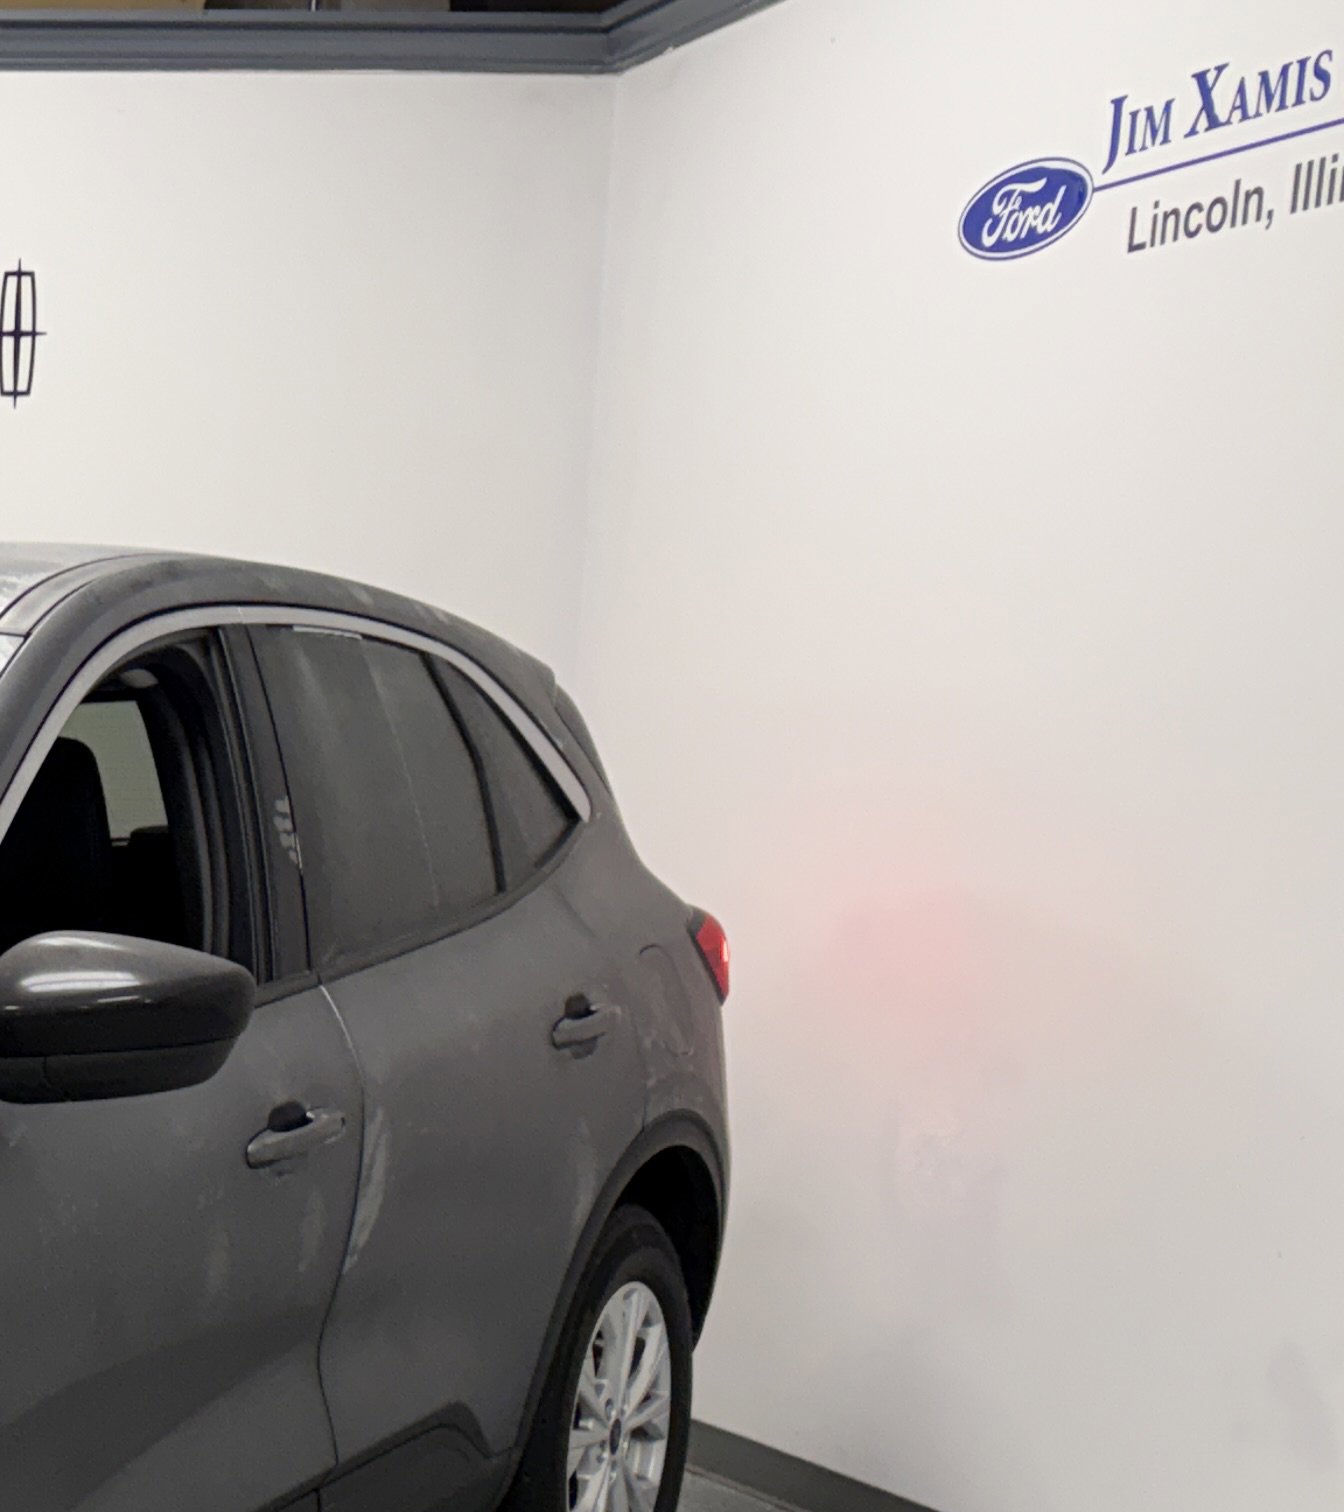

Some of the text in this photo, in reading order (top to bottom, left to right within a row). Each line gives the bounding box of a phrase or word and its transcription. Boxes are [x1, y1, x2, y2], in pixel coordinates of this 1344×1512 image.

[1183, 48, 1334, 139] XAMIS
[980, 176, 1068, 249] Ford
[1126, 177, 1275, 254] Lincoln,
